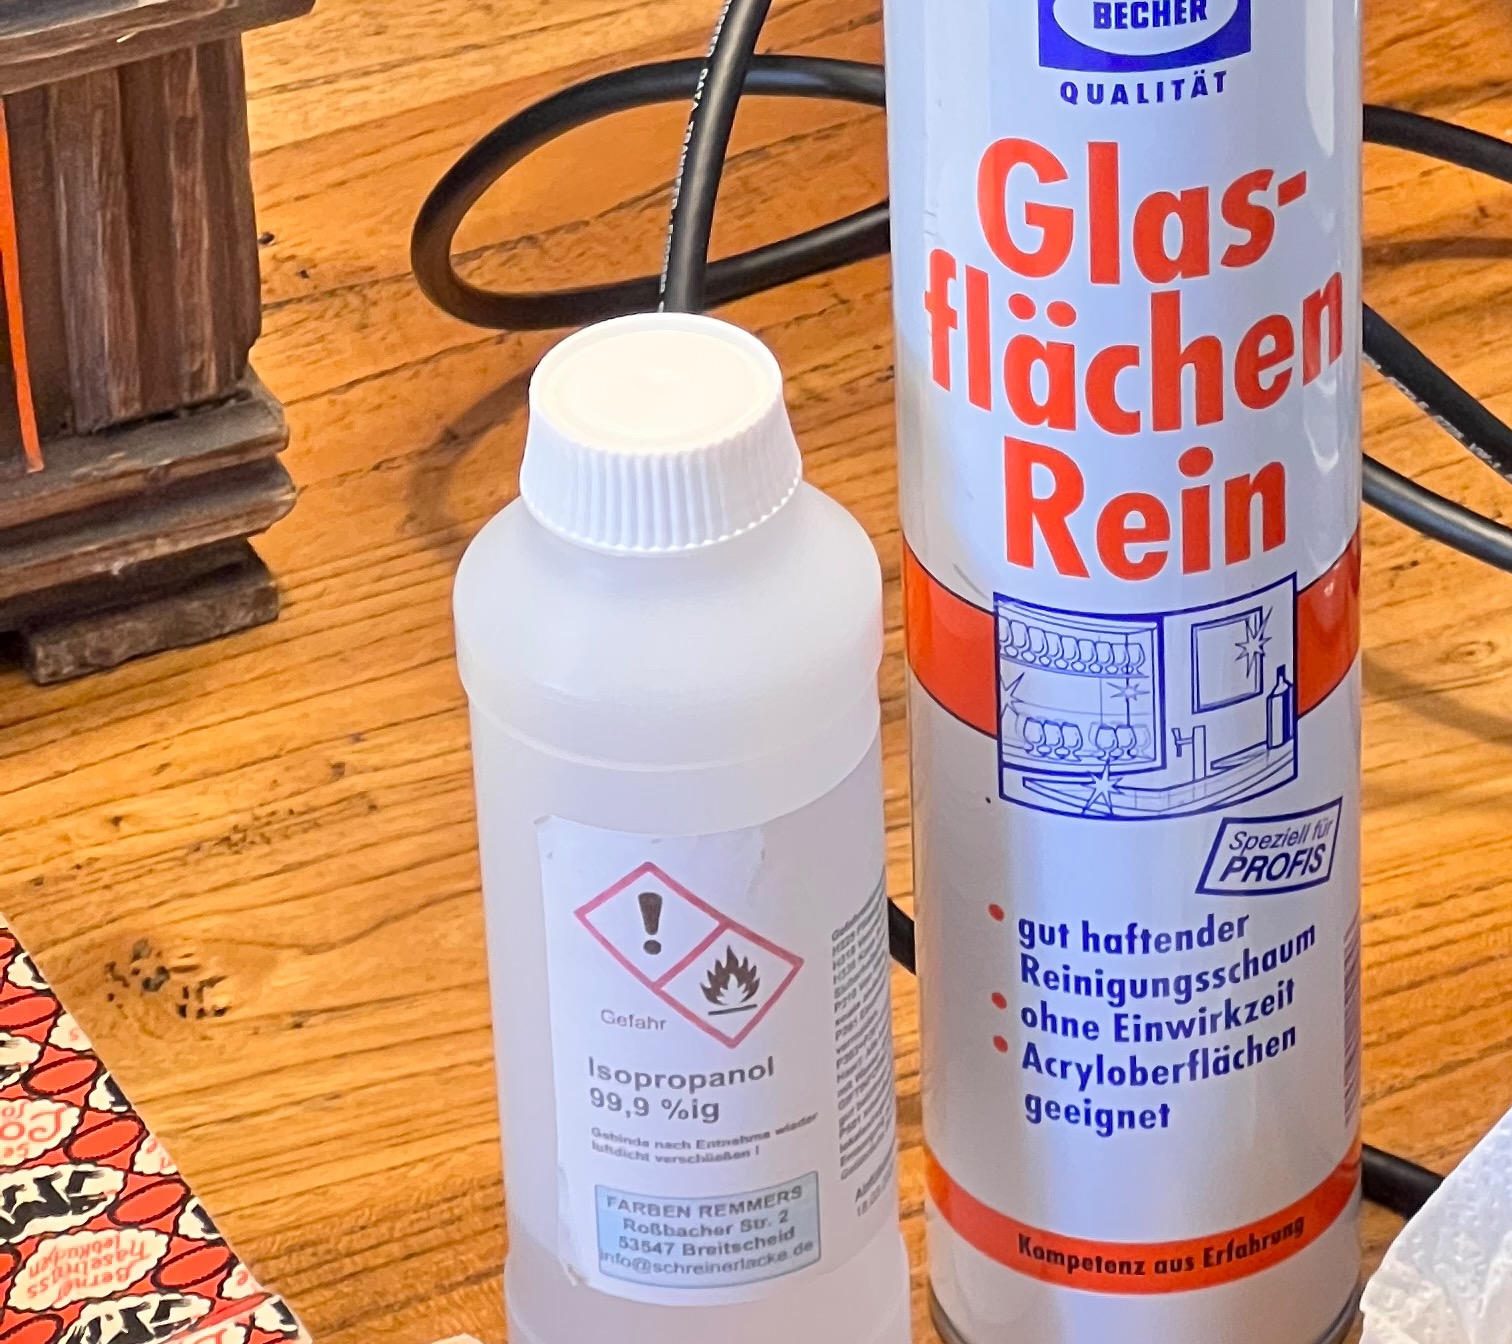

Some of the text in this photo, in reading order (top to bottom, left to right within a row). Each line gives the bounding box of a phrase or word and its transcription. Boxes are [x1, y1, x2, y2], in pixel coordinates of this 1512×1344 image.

[1060, 70, 1228, 106] QUALITÄT
[976, 136, 1307, 286] Glas-
[925, 247, 1344, 436] flächen
[1003, 435, 1288, 582] Rein
[1228, 814, 1336, 856] Speziell für
[1219, 847, 1327, 885] PROFIS
[1018, 910, 1250, 955] gut haftender
[1020, 920, 1318, 1008] Reinigungsschaum
[600, 1007, 668, 1033] Gefahr
[1020, 980, 1298, 1045] ohne Einwirkzeit
[588, 1055, 776, 1095] Isopropanol
[1020, 1020, 1299, 1095] Acryloberflächen
[589, 1086, 721, 1124] 99,9 %ig
[1024, 1091, 1171, 1138] geeignet
[606, 1183, 803, 1219] FARBEN REMMERS
[622, 1217, 734, 1238] Roßbacher
[682, 1225, 796, 1257] Breitscheid
[1017, 1214, 1307, 1278] Kompetenz aus Erfahrung
